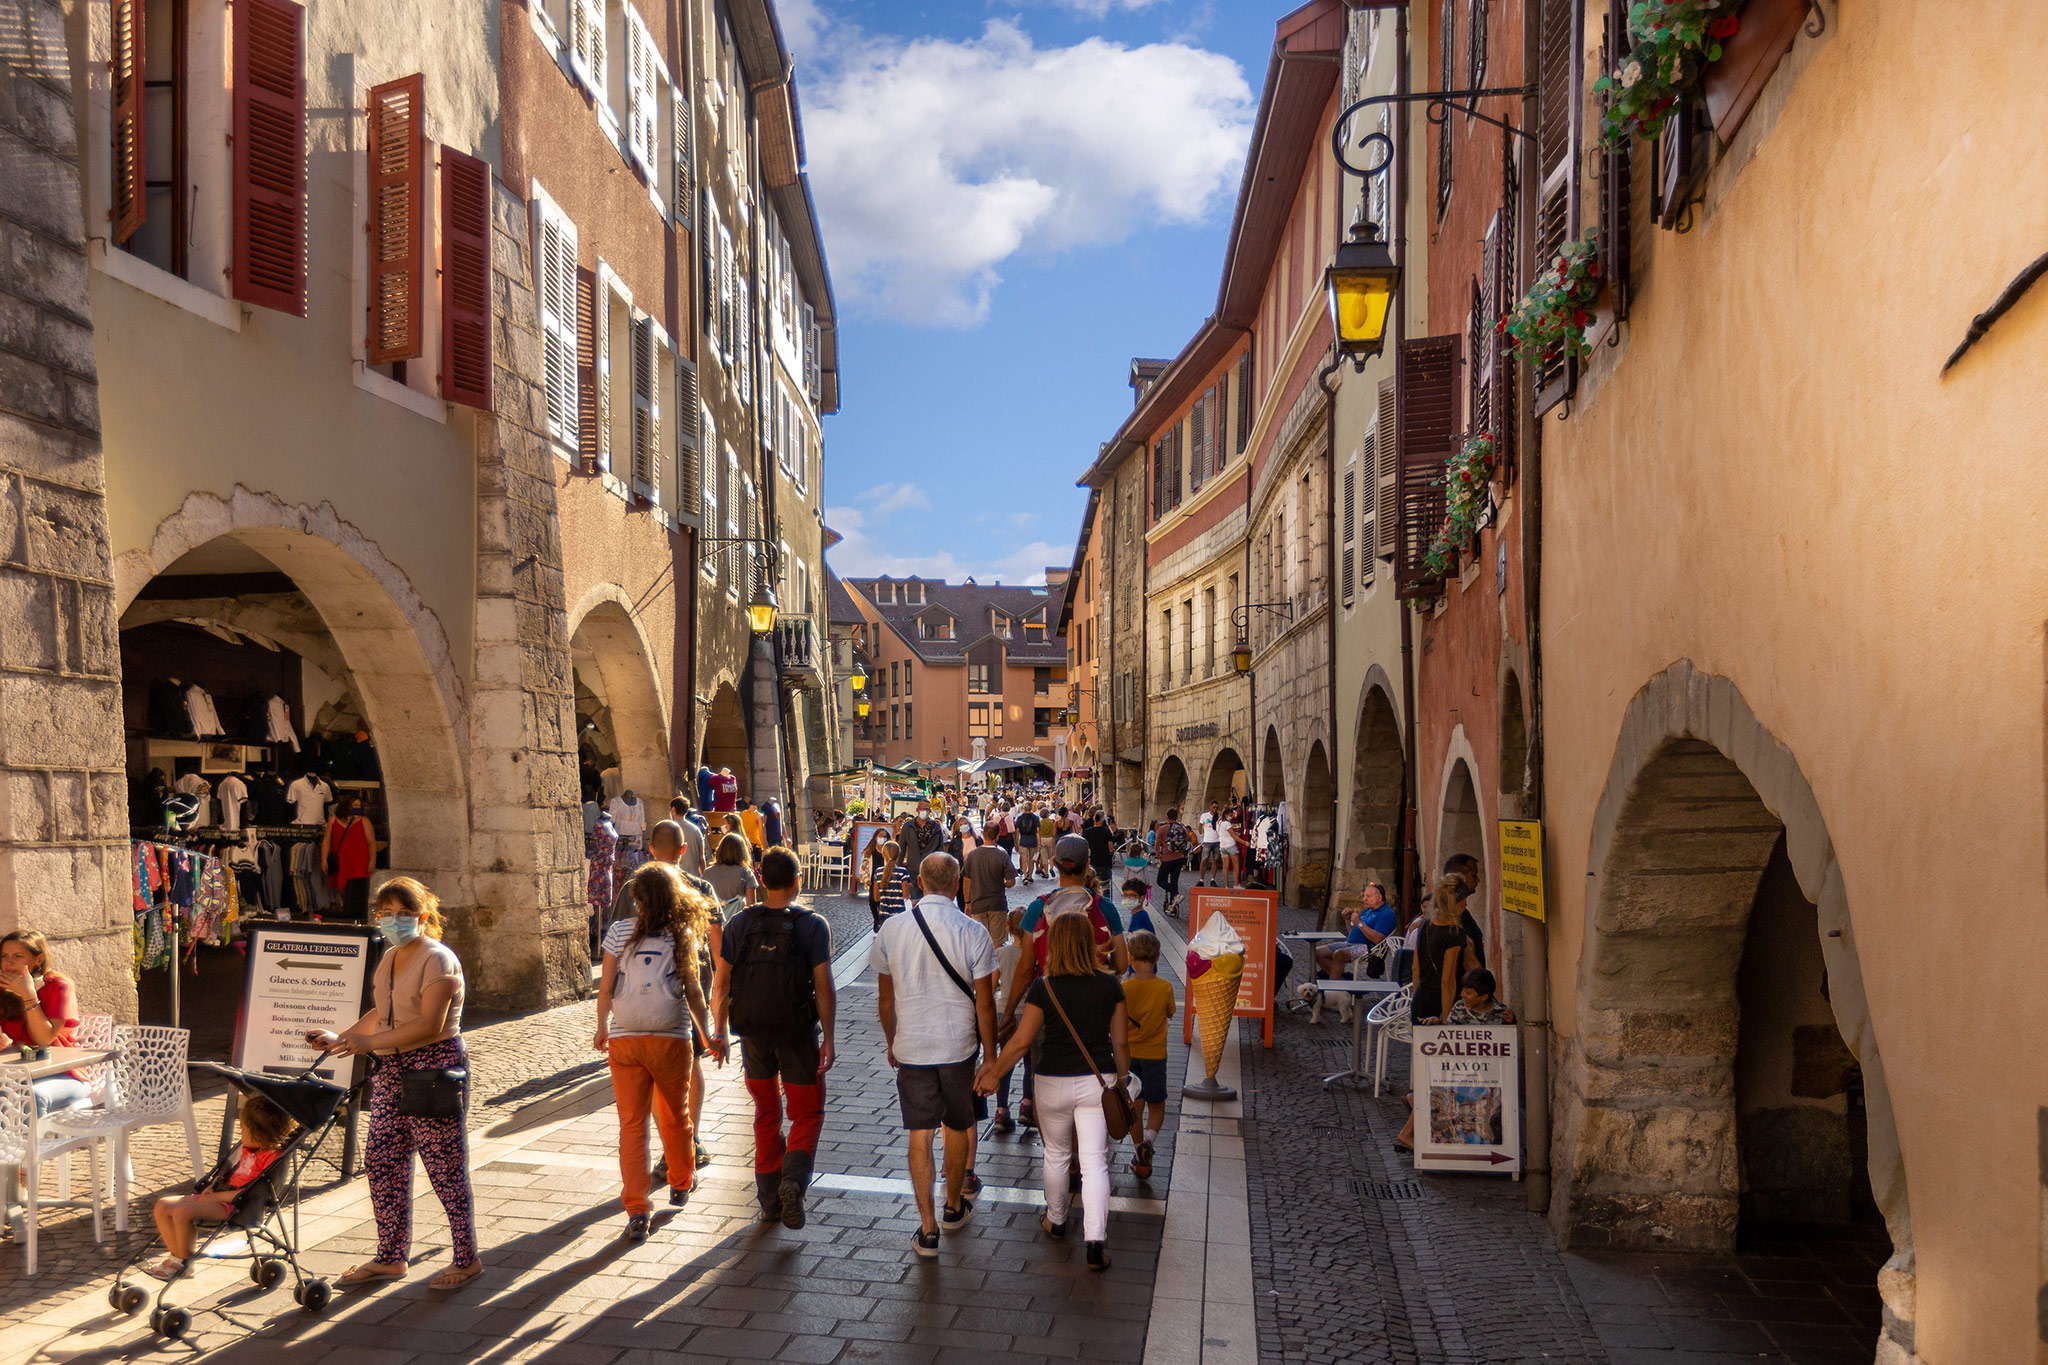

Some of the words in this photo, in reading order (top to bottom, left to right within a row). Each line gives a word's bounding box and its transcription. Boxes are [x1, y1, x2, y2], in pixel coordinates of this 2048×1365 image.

[266, 942, 308, 952] GELATERIA
[309, 945, 357, 955] L'EDELWEISS
[269, 975, 299, 985] Glaces
[310, 977, 346, 987] Sorbets
[329, 989, 344, 997] place
[273, 1002, 306, 1010] Boissons
[307, 1004, 337, 1012] chaudes
[271, 1015, 304, 1023] Boissons
[284, 1028, 293, 1036] de
[1437, 1030, 1493, 1041] ATELIER
[1420, 1041, 1511, 1057] GALERIE
[279, 1054, 296, 1062] Milk
[1441, 1062, 1490, 1072] HAYOT
